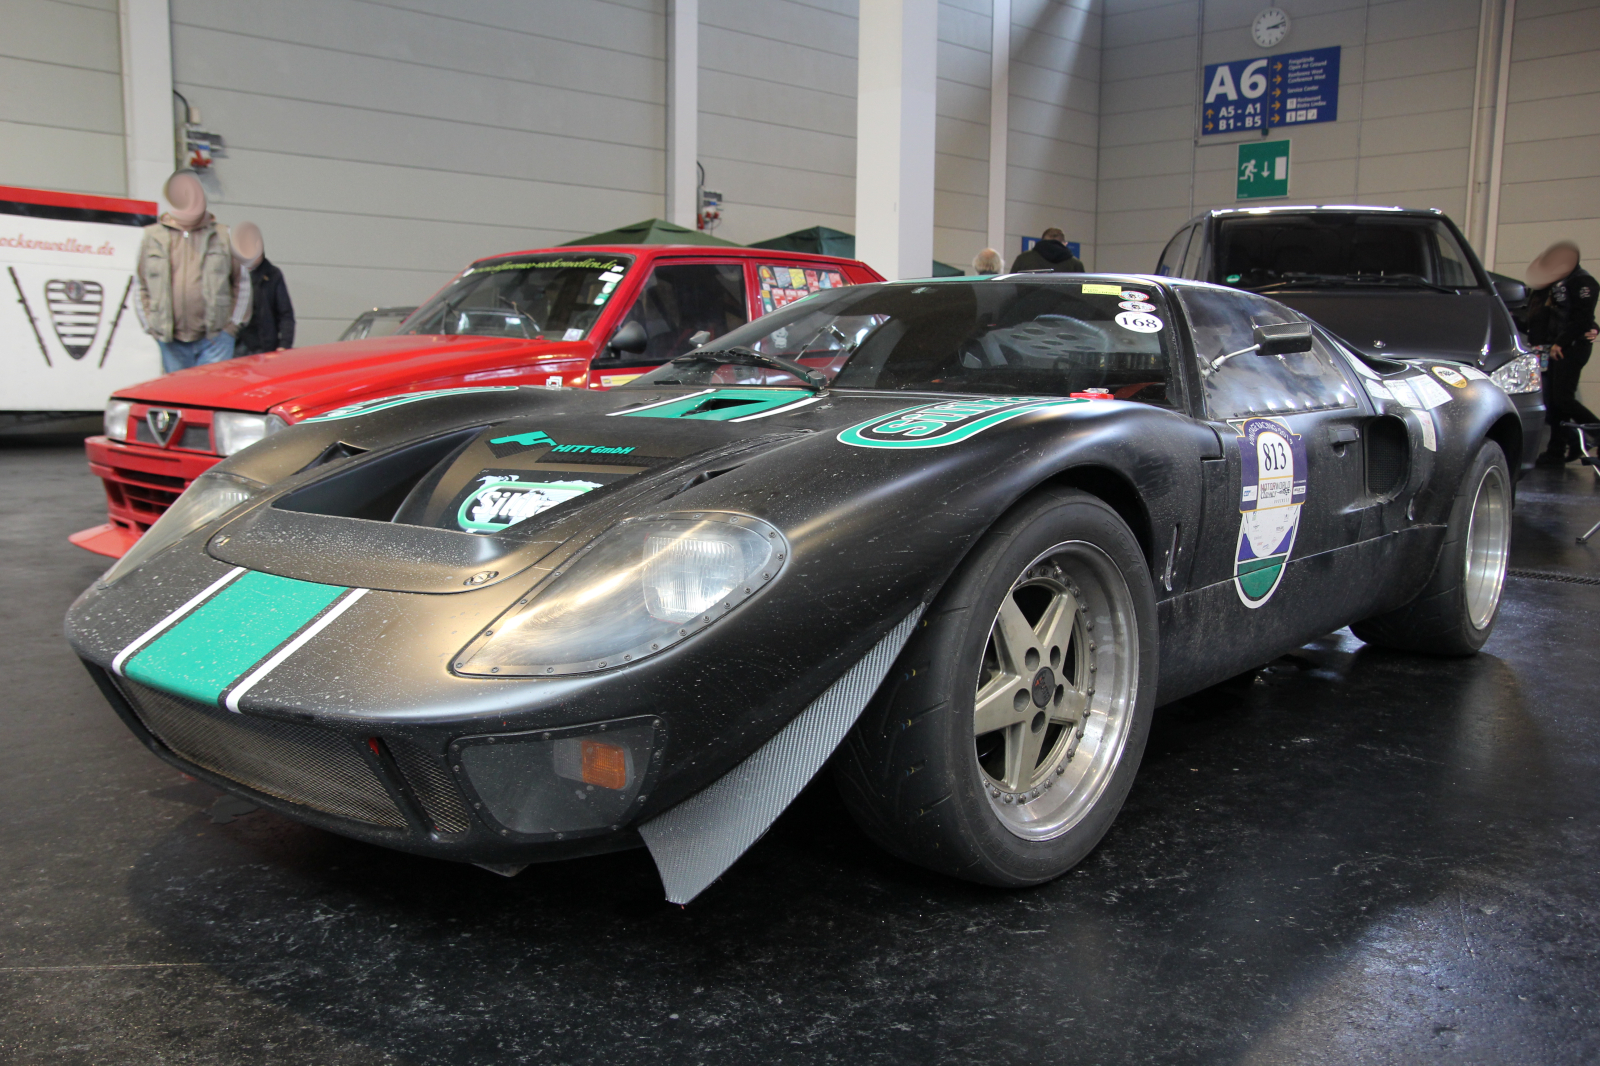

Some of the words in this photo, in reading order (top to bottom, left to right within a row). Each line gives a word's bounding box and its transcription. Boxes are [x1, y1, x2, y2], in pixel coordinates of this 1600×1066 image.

[1205, 59, 1268, 104] A6
[1219, 106, 1235, 118] A5
[1245, 102, 1261, 115] A1
[1219, 118, 1234, 130] B1
[1245, 115, 1261, 128] B5
[1122, 317, 1157, 329] 168
[551, 444, 596, 453] HITT
[590, 445, 636, 455] GmbH
[1262, 442, 1287, 471] 813
